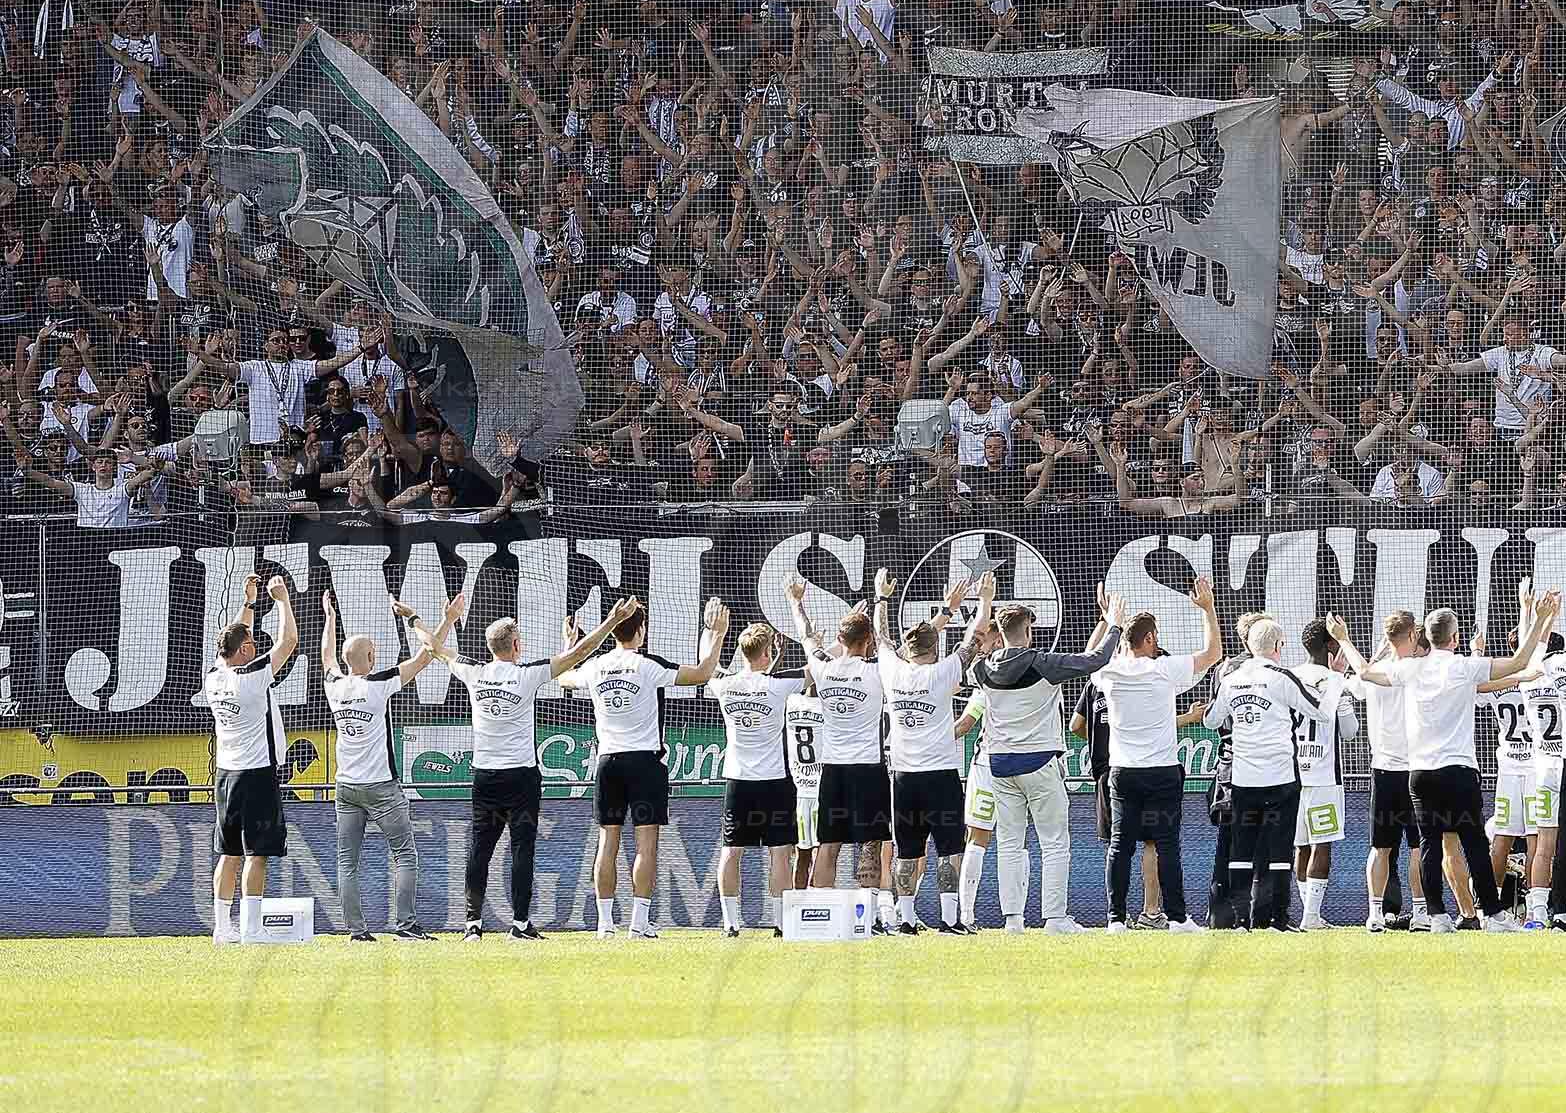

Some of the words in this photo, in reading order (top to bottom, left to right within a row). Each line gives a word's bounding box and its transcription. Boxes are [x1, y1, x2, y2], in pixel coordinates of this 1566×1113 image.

[937, 82, 1046, 105] MURT
[64, 536, 867, 716] JEWELS
[597, 679, 641, 695] PUNTIGAMER
[819, 687, 867, 703] PUNTIGAMER
[475, 689, 522, 705] PUNTIGAMER
[725, 701, 773, 716] PUNTIGAMER
[795, 725, 817, 765] 8
[263, 915, 293, 925] pure
